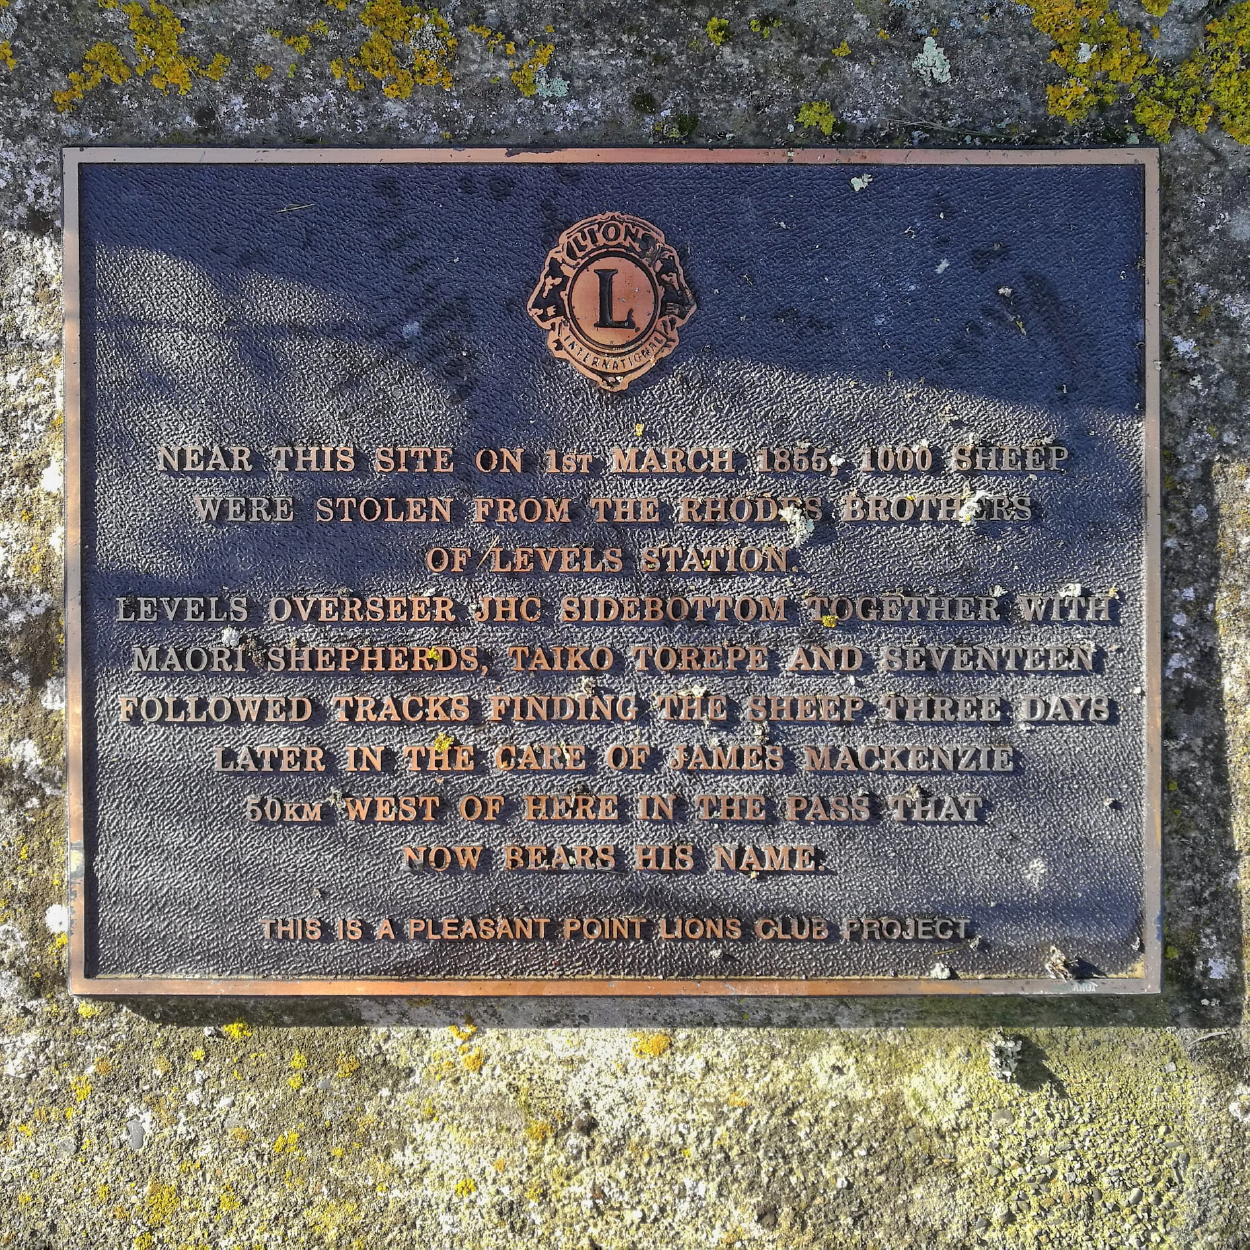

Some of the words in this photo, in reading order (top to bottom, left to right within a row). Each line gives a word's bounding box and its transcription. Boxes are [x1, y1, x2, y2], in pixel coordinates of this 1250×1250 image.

[565, 221, 656, 261] LIONS
[563, 335, 665, 371] INTERNATIONAL
[157, 447, 253, 473] NEAR
[274, 447, 355, 473] THIS
[375, 447, 454, 473] SITE
[474, 448, 525, 474] ON
[613, 448, 736, 474] MARCH
[757, 447, 839, 478] 1855,
[861, 447, 933, 473] 1000
[952, 446, 1069, 472] SHEEP
[195, 497, 293, 523] WERE
[315, 497, 452, 523] STOLEN
[473, 497, 572, 523] FROM
[590, 497, 660, 523] THE
[426, 547, 471, 573] OF
[490, 547, 624, 573] LEVELS
[642, 547, 799, 573] STATION.
[115, 597, 248, 623] LEVELS
[268, 597, 456, 623] OVERSEER
[475, 596, 542, 622] JHC
[561, 596, 788, 622] SIDEBOTTOM
[807, 596, 1001, 622] TOGETHER
[1019, 596, 1112, 622] WITH
[132, 647, 246, 672] MAORI
[267, 646, 488, 676] SHEPHERDS,
[508, 646, 614, 672] TAIKO
[631, 646, 769, 672] TOREPE
[789, 646, 863, 672] AND
[883, 646, 1094, 672] SEVENTEEN
[118, 696, 313, 722] FOLLOWED
[332, 696, 471, 722] TRACKS
[491, 696, 637, 721] FINDING
[656, 696, 728, 721] THE
[749, 696, 864, 721] SHEEP
[886, 695, 1001, 721] THREE
[1020, 695, 1110, 722] DAYS
[214, 746, 326, 772] LATER
[347, 746, 384, 772] IN
[406, 746, 475, 771] THE
[495, 745, 586, 771] CARE
[605, 745, 650, 771] OF
[671, 745, 784, 771] JAMES
[803, 745, 1014, 771] MACKENZIE
[346, 796, 440, 822] WEST
[460, 796, 505, 822] OF
[525, 795, 618, 821] HERE
[638, 795, 677, 821] IN
[697, 795, 767, 821] THE
[786, 795, 871, 821] PASS
[890, 795, 983, 821] THAT
[402, 846, 483, 872] NOW
[504, 845, 617, 871] BEARS
[636, 845, 694, 871] HIS
[713, 845, 825, 871] NAME.
[260, 918, 322, 940] THIS
[338, 918, 362, 940] IS
[377, 918, 396, 940] A
[409, 918, 550, 940] PLEASANT
[564, 917, 647, 940] POINT
[660, 917, 742, 940] LIONS
[754, 917, 829, 940] CLUB
[847, 917, 971, 940] PROJECT
